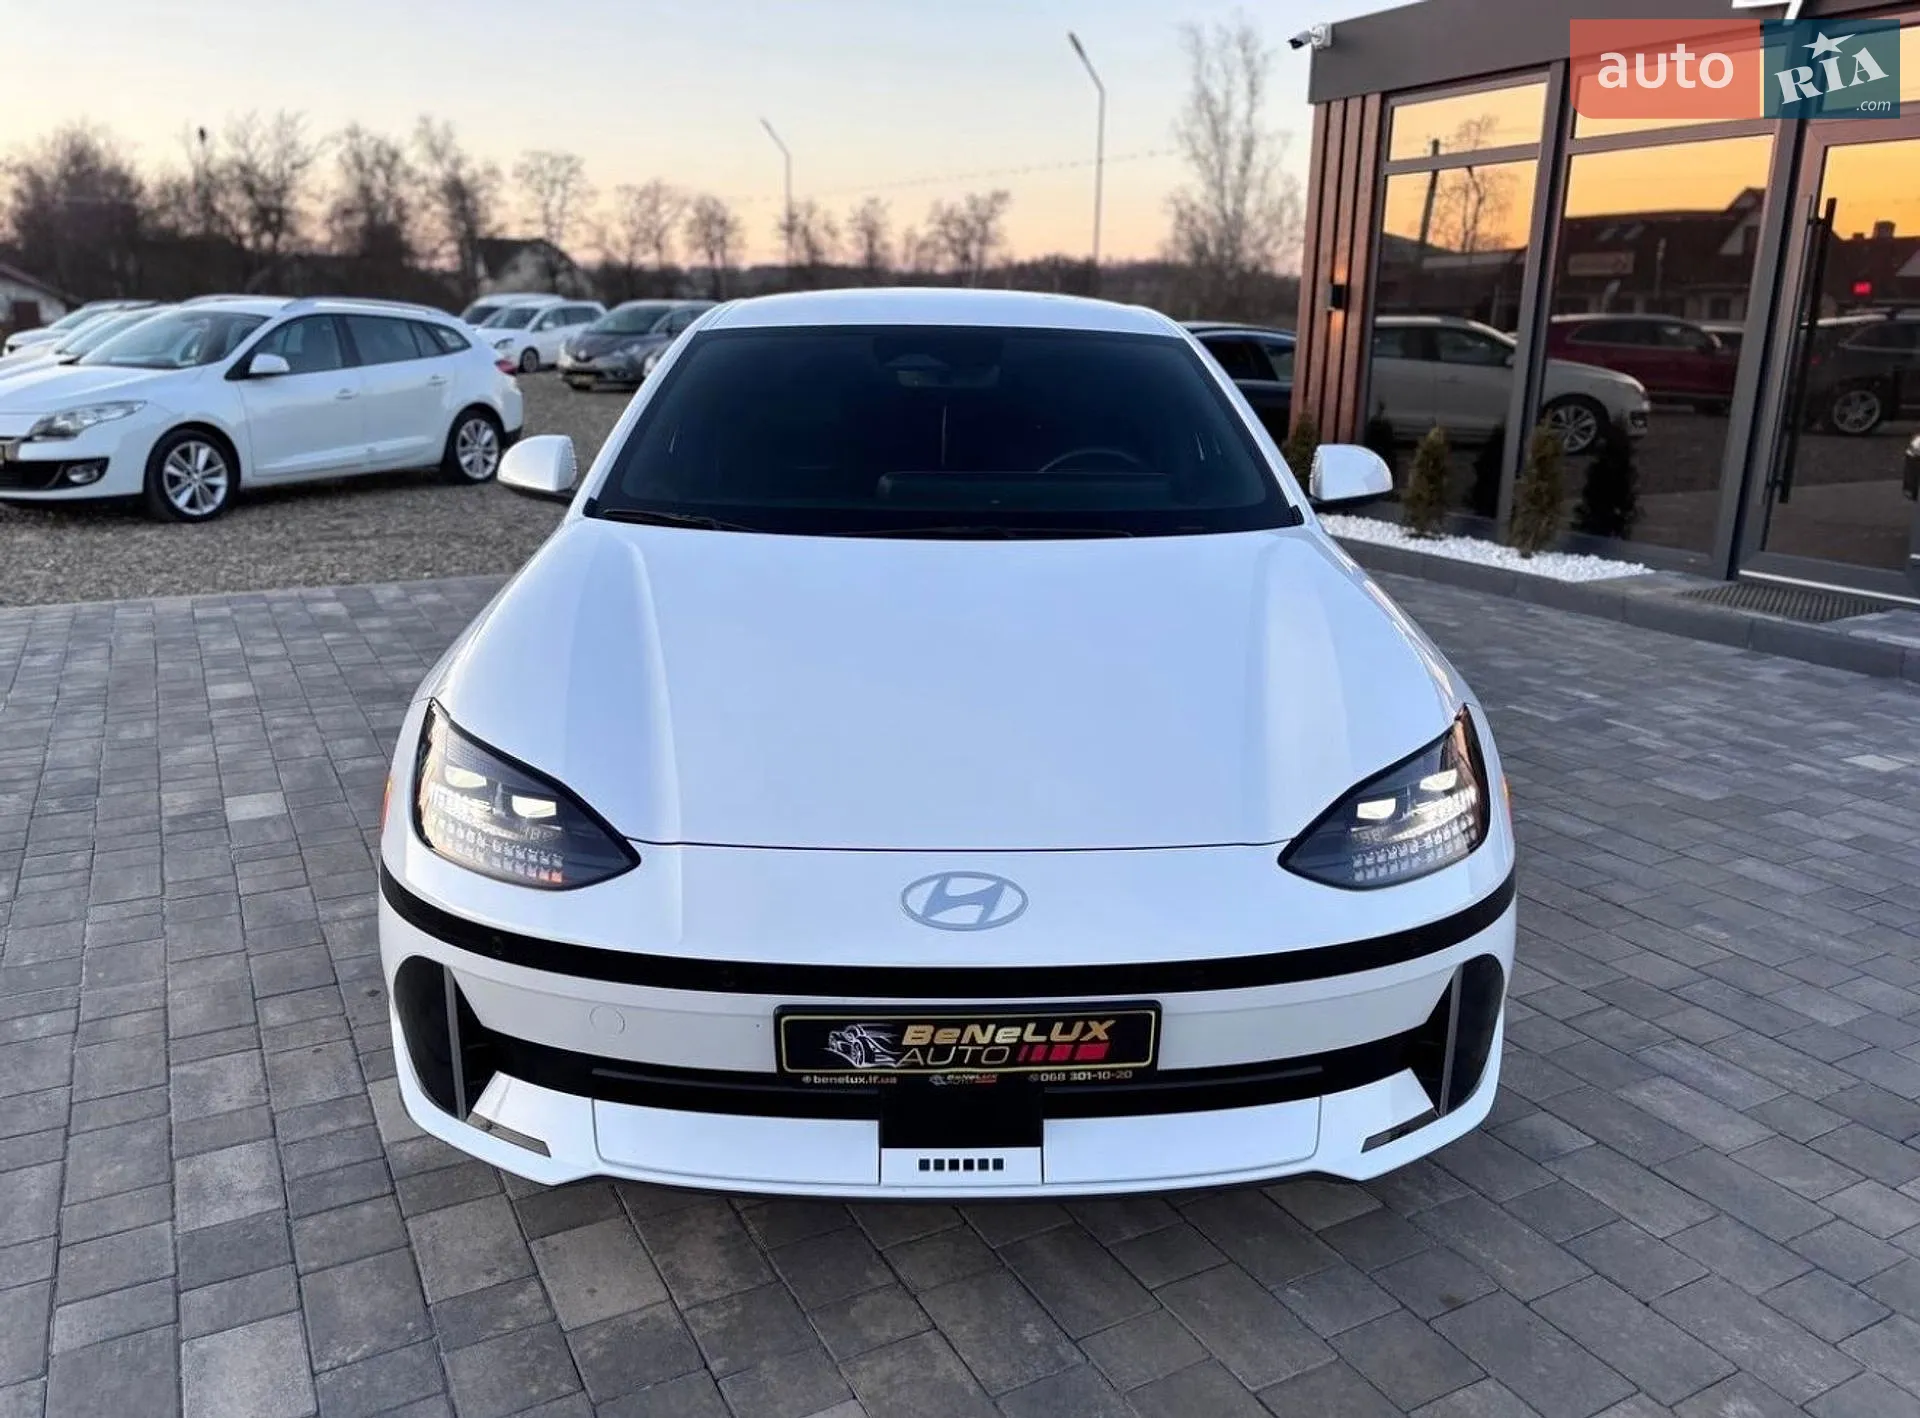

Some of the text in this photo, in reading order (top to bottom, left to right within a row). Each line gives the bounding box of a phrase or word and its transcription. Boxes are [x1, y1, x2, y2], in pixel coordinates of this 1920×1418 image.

[896, 1045, 1011, 1067] AUTO
[813, 1074, 898, 1085] benelux.if.ua
[1069, 1069, 1133, 1081] 301-10-20
